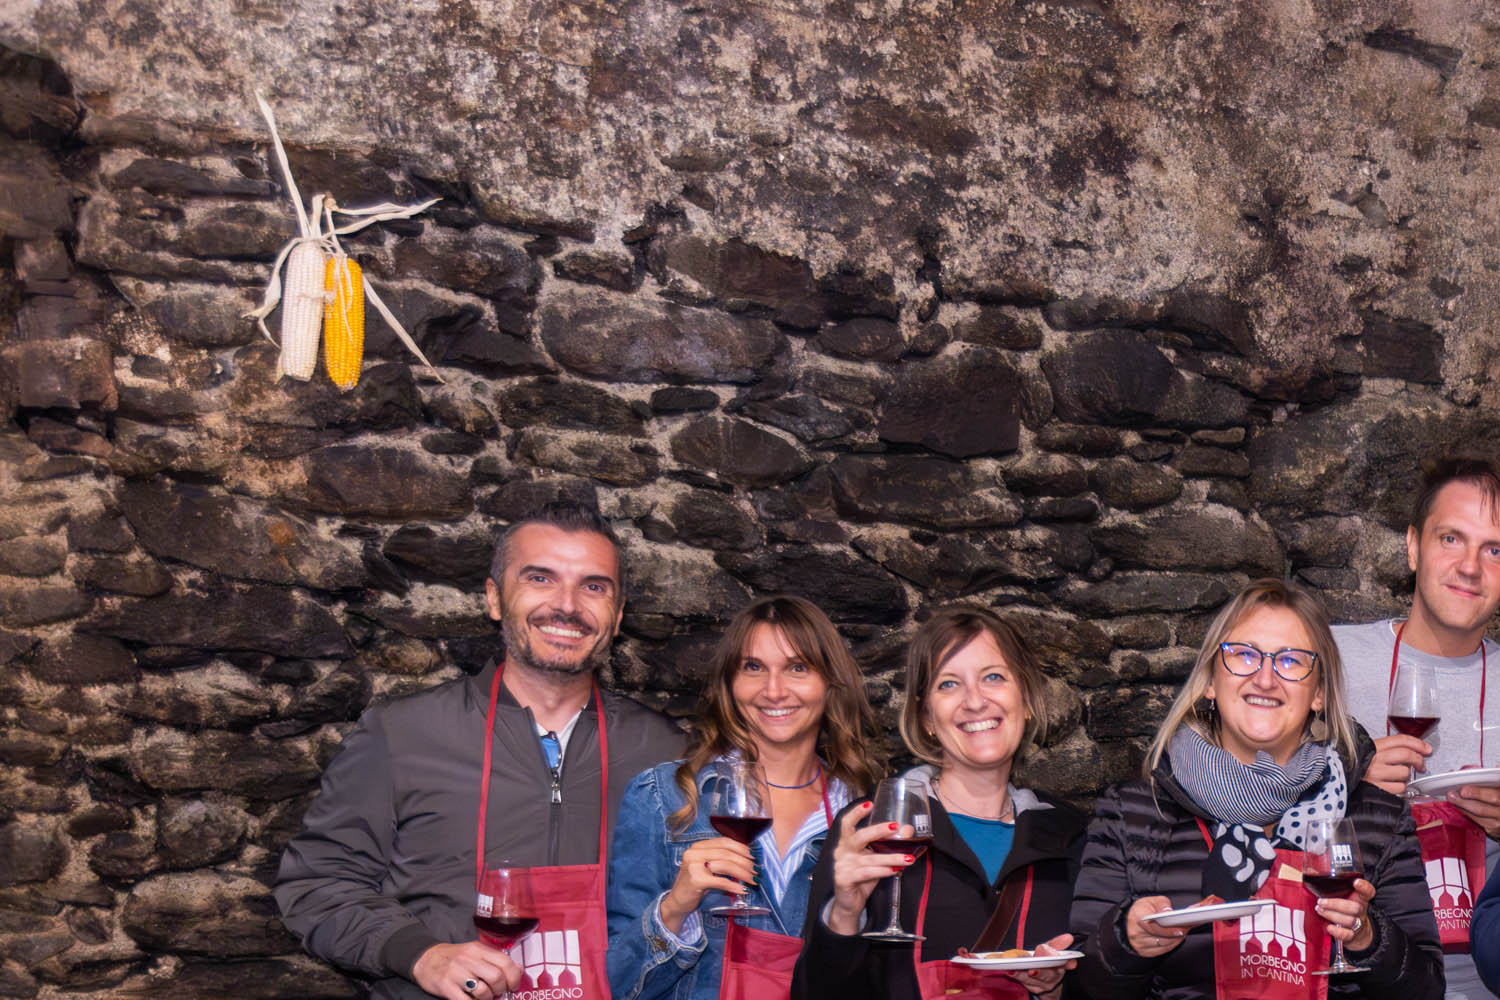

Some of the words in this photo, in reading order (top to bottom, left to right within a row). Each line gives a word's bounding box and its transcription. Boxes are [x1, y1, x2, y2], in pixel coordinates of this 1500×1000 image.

[1240, 954, 1307, 975] MORBEGNO
[1241, 968, 1254, 980] IN
[1257, 966, 1305, 987] CANTINA
